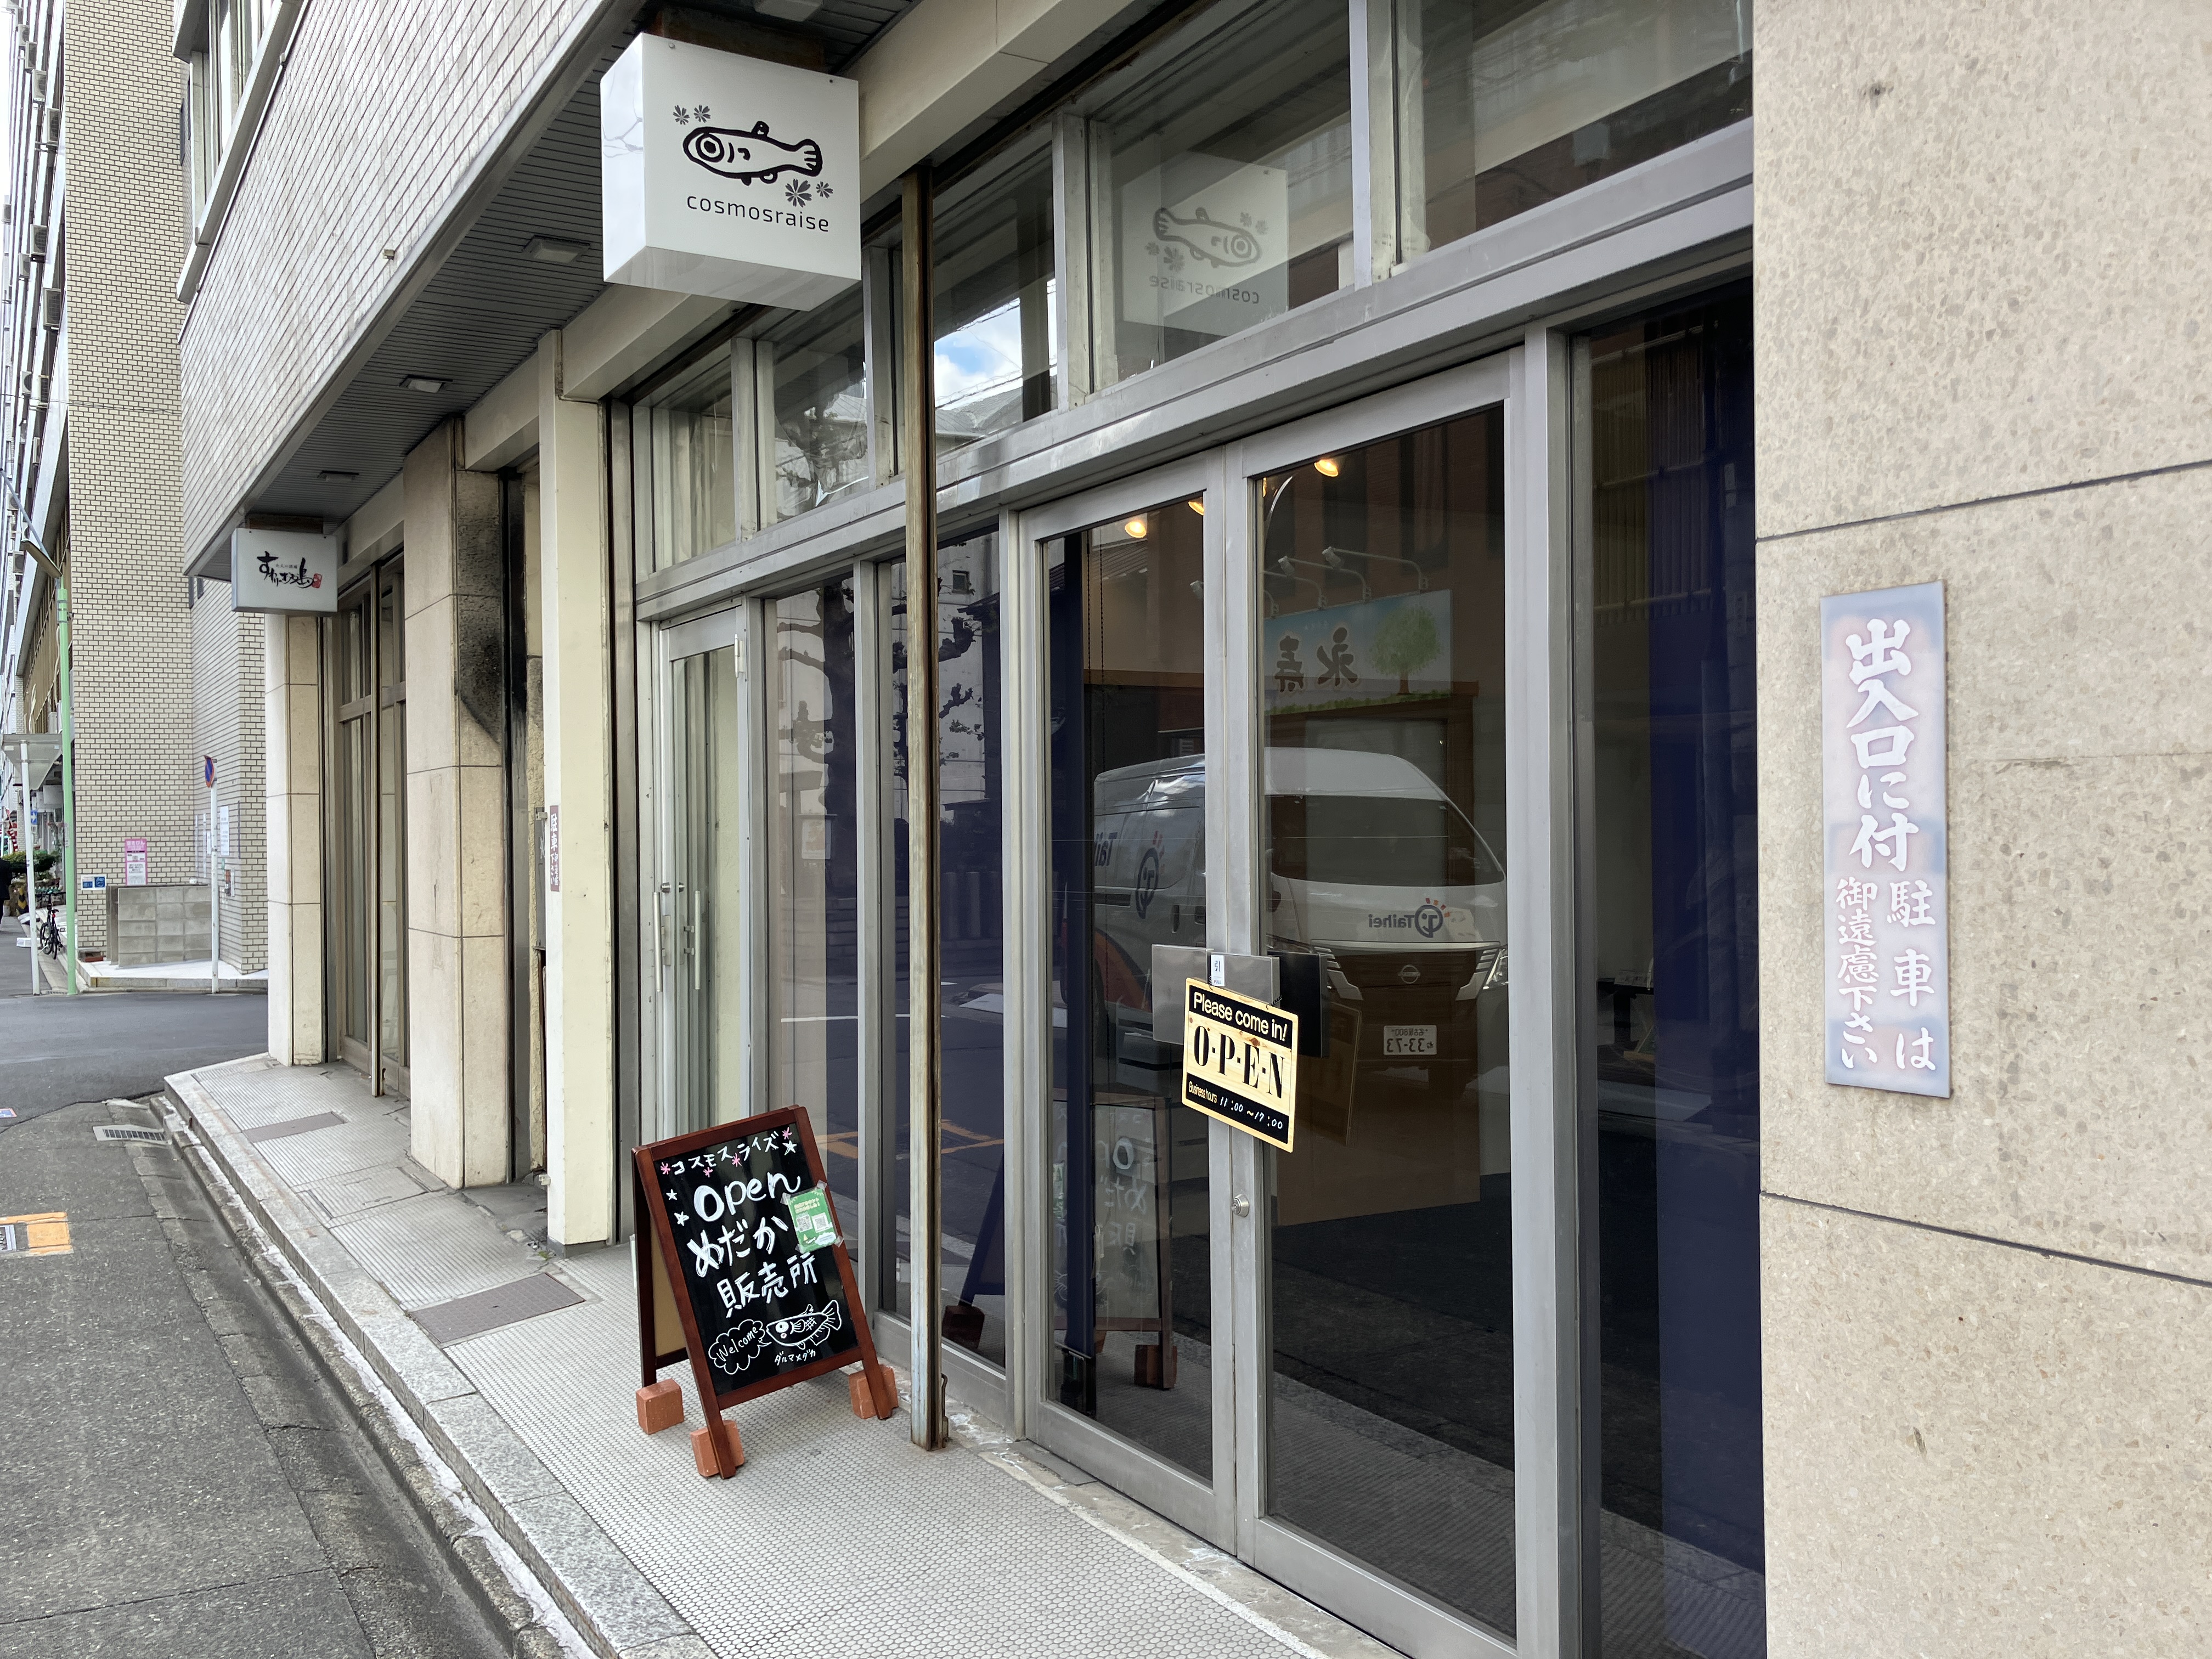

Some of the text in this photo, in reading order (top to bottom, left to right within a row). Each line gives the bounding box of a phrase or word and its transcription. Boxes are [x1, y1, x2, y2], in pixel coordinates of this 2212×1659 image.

[687, 195, 830, 233] cosmosraise
[1844, 618, 1919, 871] 出入口に付
[1835, 877, 1878, 1070] 御遠慮下さい
[1887, 879, 1937, 1072] 駐車は
[1193, 991, 1288, 1042] Please come in!
[1188, 1081, 1205, 1099] Business
[1205, 1087, 1217, 1104] hours
[672, 1131, 779, 1175] コスモスライズ
[687, 1215, 789, 1278] めだか
[716, 1250, 818, 1318] 販売所
[715, 1326, 759, 1362] Welcome
[774, 1348, 817, 1366] ダルマメダカ
